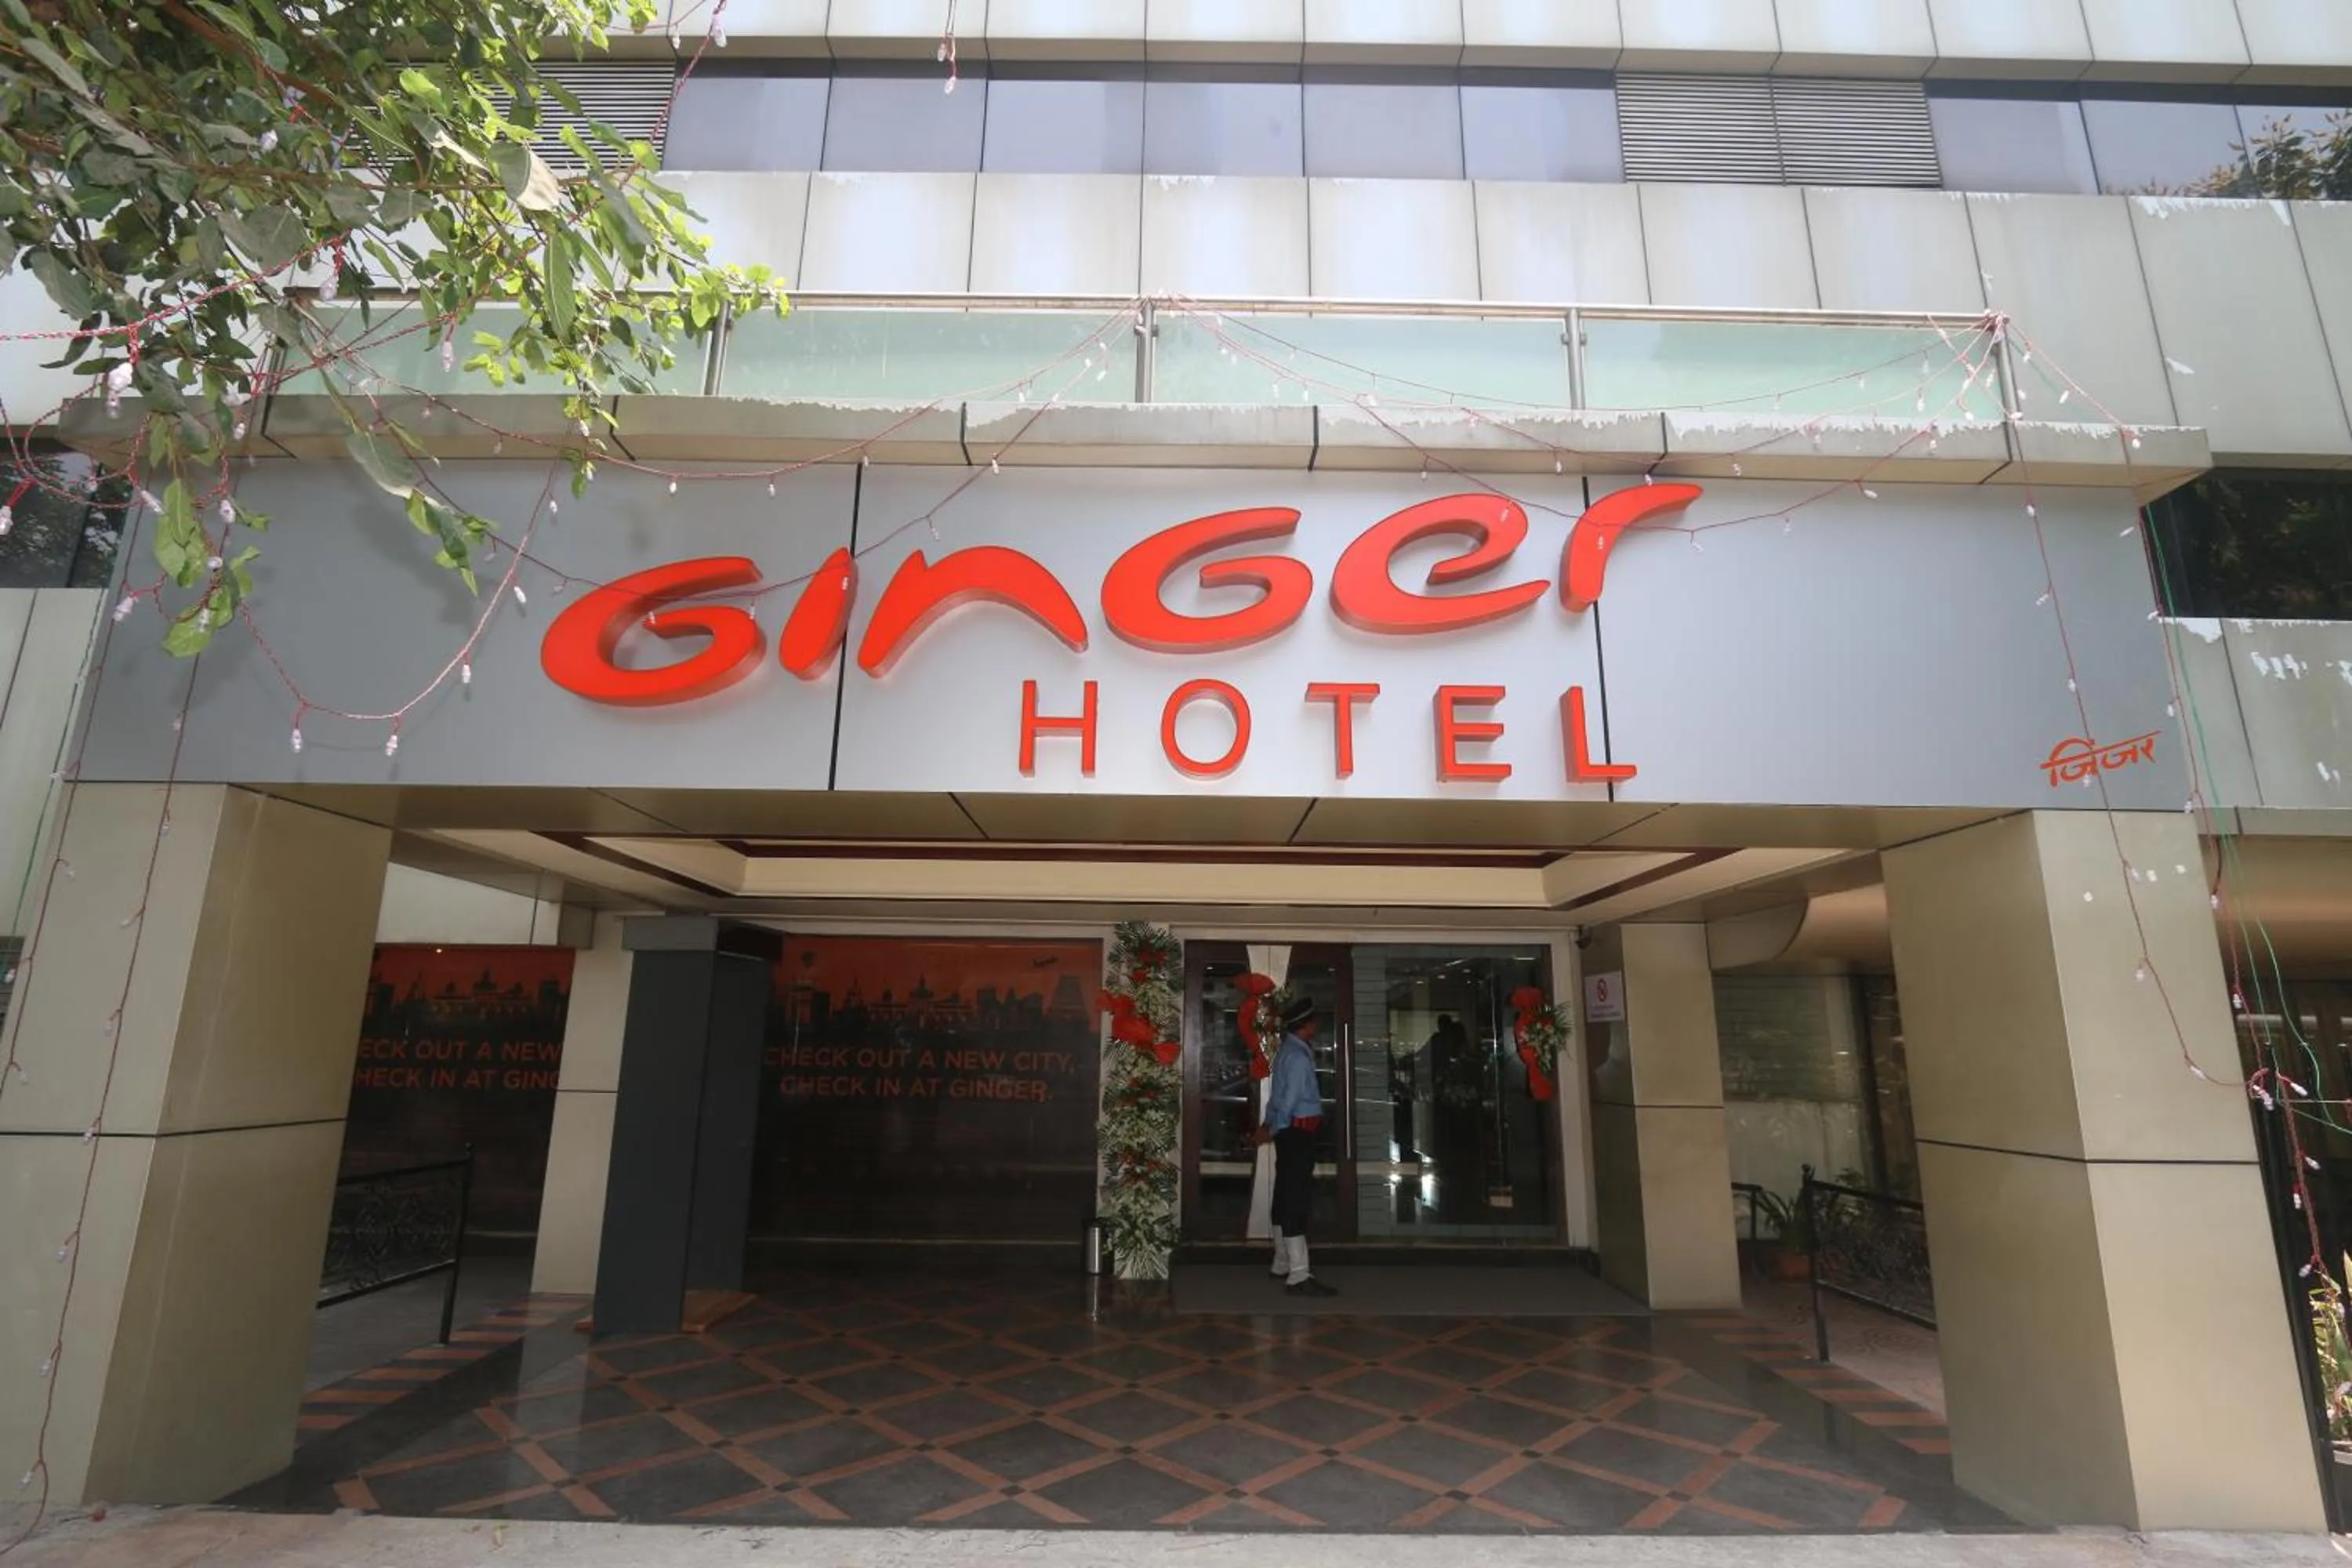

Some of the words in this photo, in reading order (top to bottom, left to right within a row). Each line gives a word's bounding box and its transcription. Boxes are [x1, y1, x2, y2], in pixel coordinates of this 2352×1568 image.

[1019, 679, 1637, 783] HOTEL
[416, 1039, 469, 1059] OUT
[474, 1040, 492, 1059] A
[501, 1041, 562, 1062] NEW
[764, 1047, 848, 1068] CHECK
[857, 1047, 910, 1069] OUT
[917, 1050, 937, 1069] A
[944, 1051, 1005, 1071] NEW
[430, 1068, 456, 1088] IN
[463, 1069, 496, 1091] AT
[780, 1075, 866, 1098] CHECK
[875, 1077, 901, 1097] IN
[908, 1077, 940, 1098] AT
